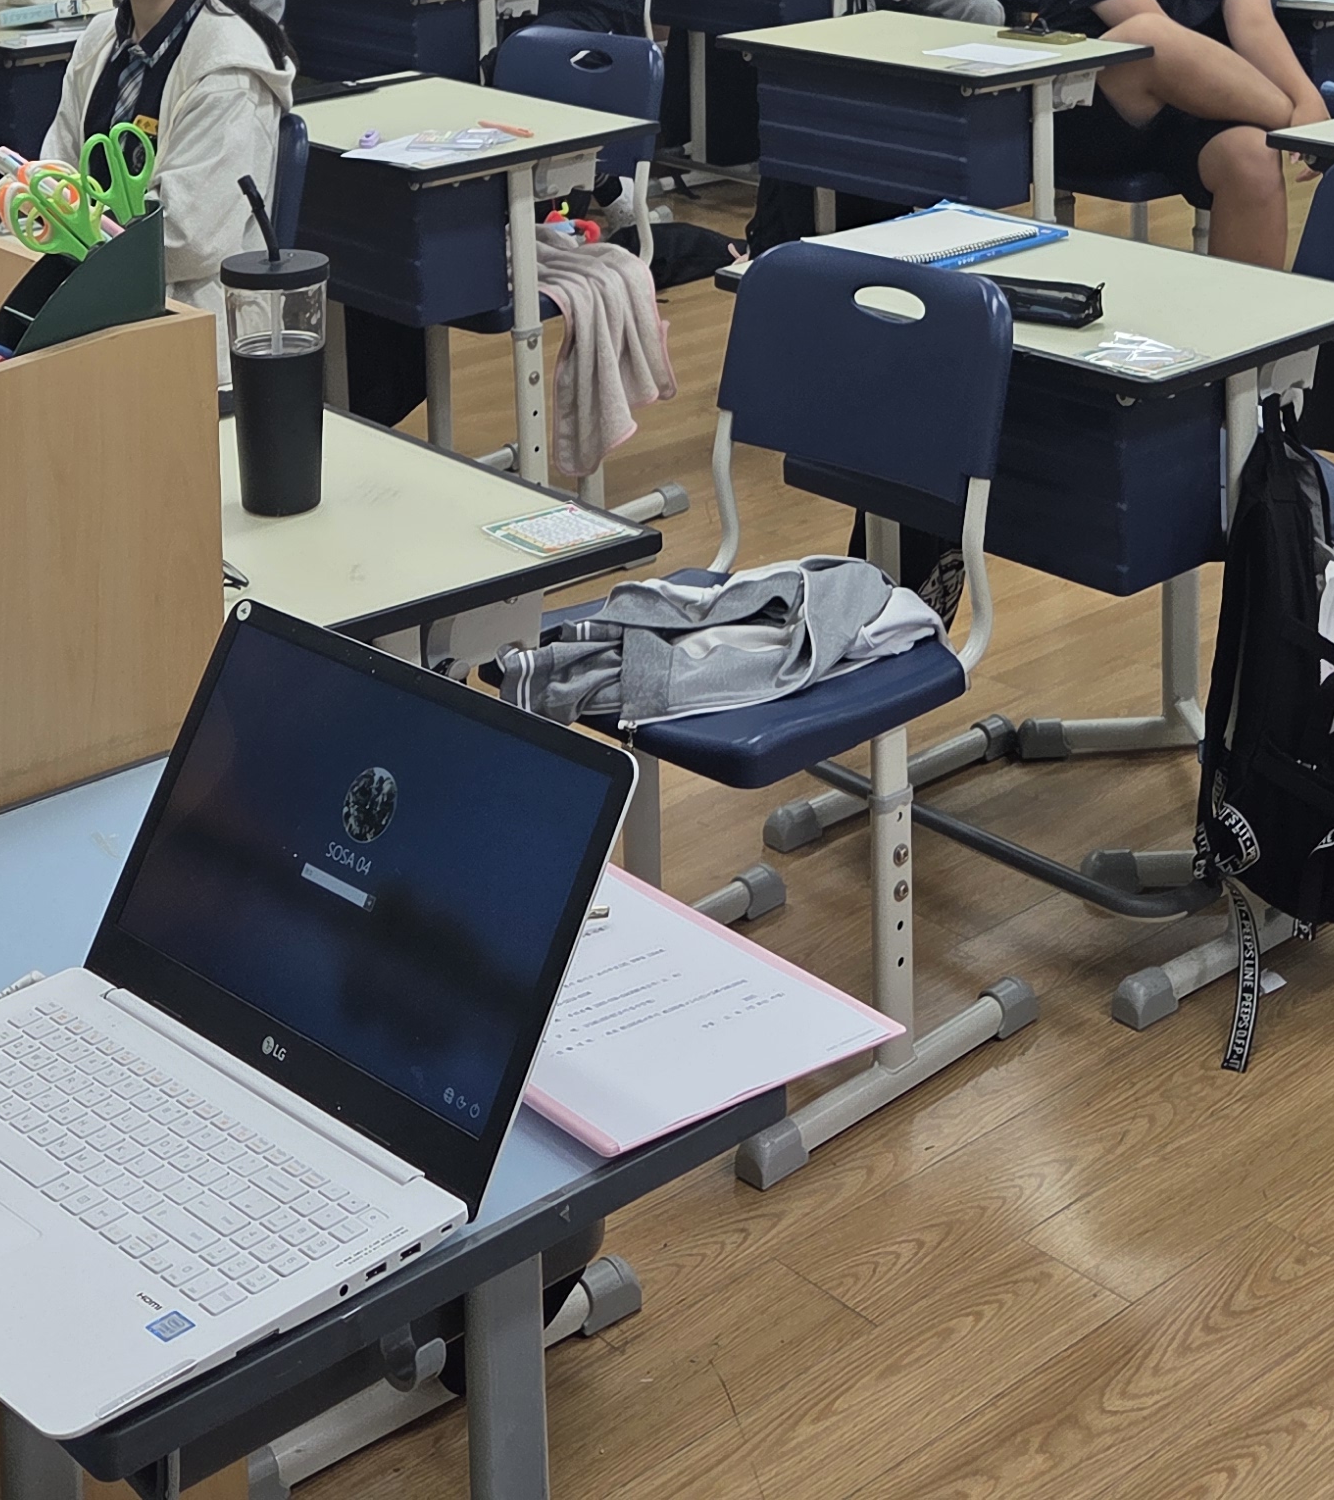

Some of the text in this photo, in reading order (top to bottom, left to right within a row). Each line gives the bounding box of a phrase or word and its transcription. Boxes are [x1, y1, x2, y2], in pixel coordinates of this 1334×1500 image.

[325, 841, 372, 876] SOSA 04
[1241, 920, 1255, 958] PEEPS
[1243, 960, 1255, 988] LINE
[1237, 992, 1253, 1029] PEEPS
[272, 1043, 287, 1061] LG
[136, 1292, 163, 1311] HDMI
